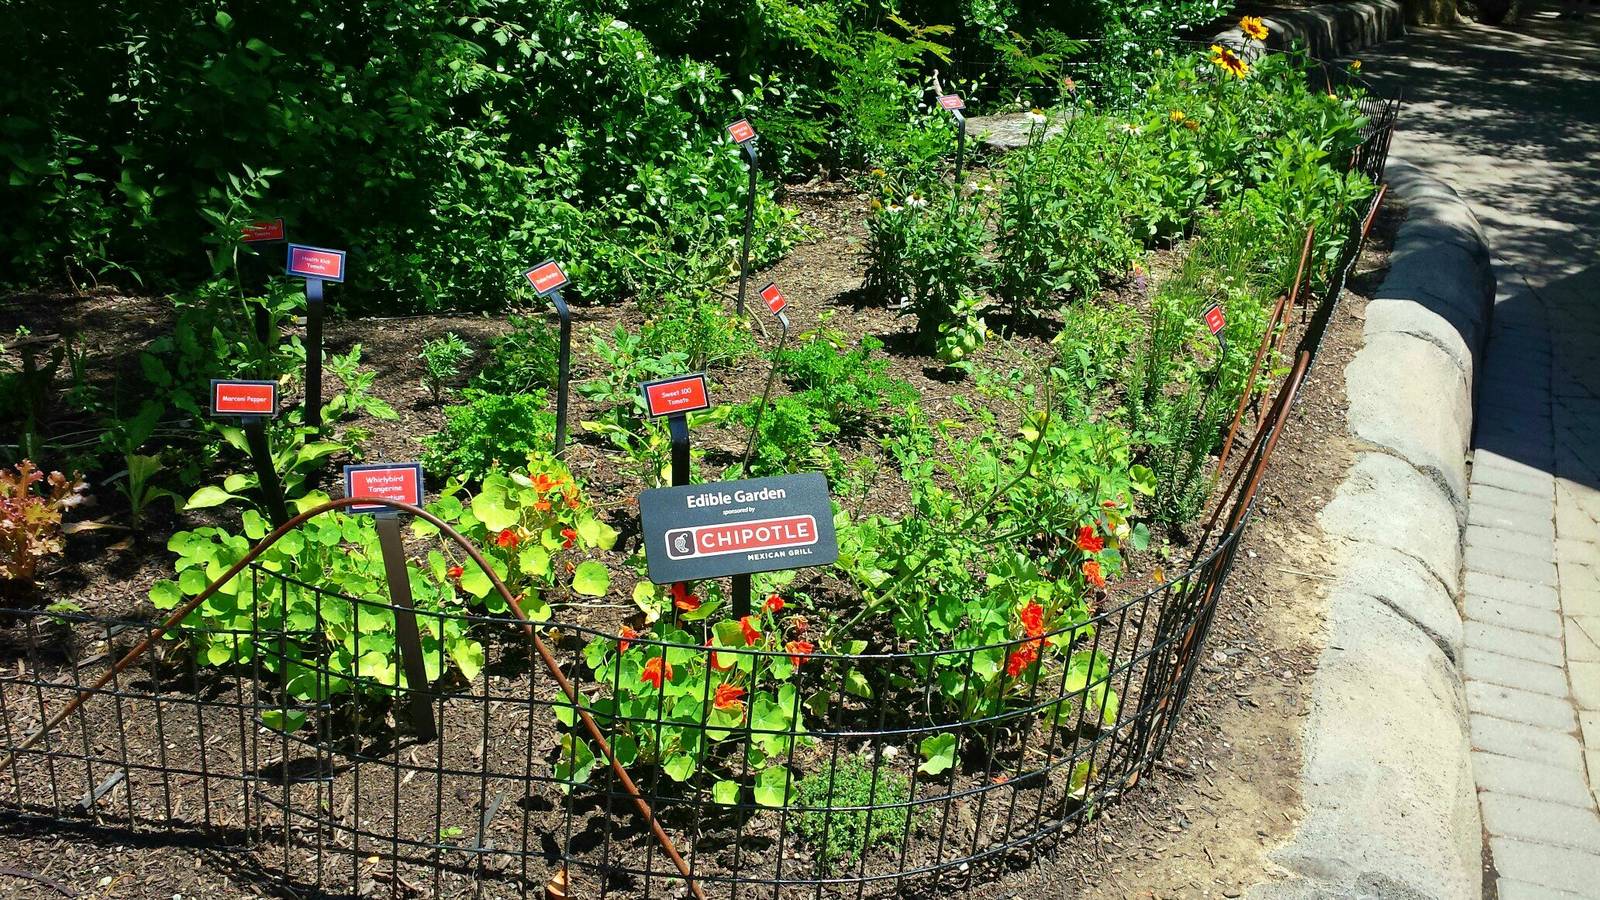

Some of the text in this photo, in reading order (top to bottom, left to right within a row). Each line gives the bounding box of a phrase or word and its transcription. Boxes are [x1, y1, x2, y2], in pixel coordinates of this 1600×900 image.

[662, 390, 680, 398] Sweet
[246, 396, 267, 404] Pepper
[366, 475, 404, 485] Whirlybird
[368, 485, 403, 493] Tangerine
[686, 487, 786, 508] Edible Garden
[722, 506, 756, 516] sponsored by
[701, 522, 810, 548] CHIPOTLE
[747, 548, 813, 561] MEXICAN GRILL
